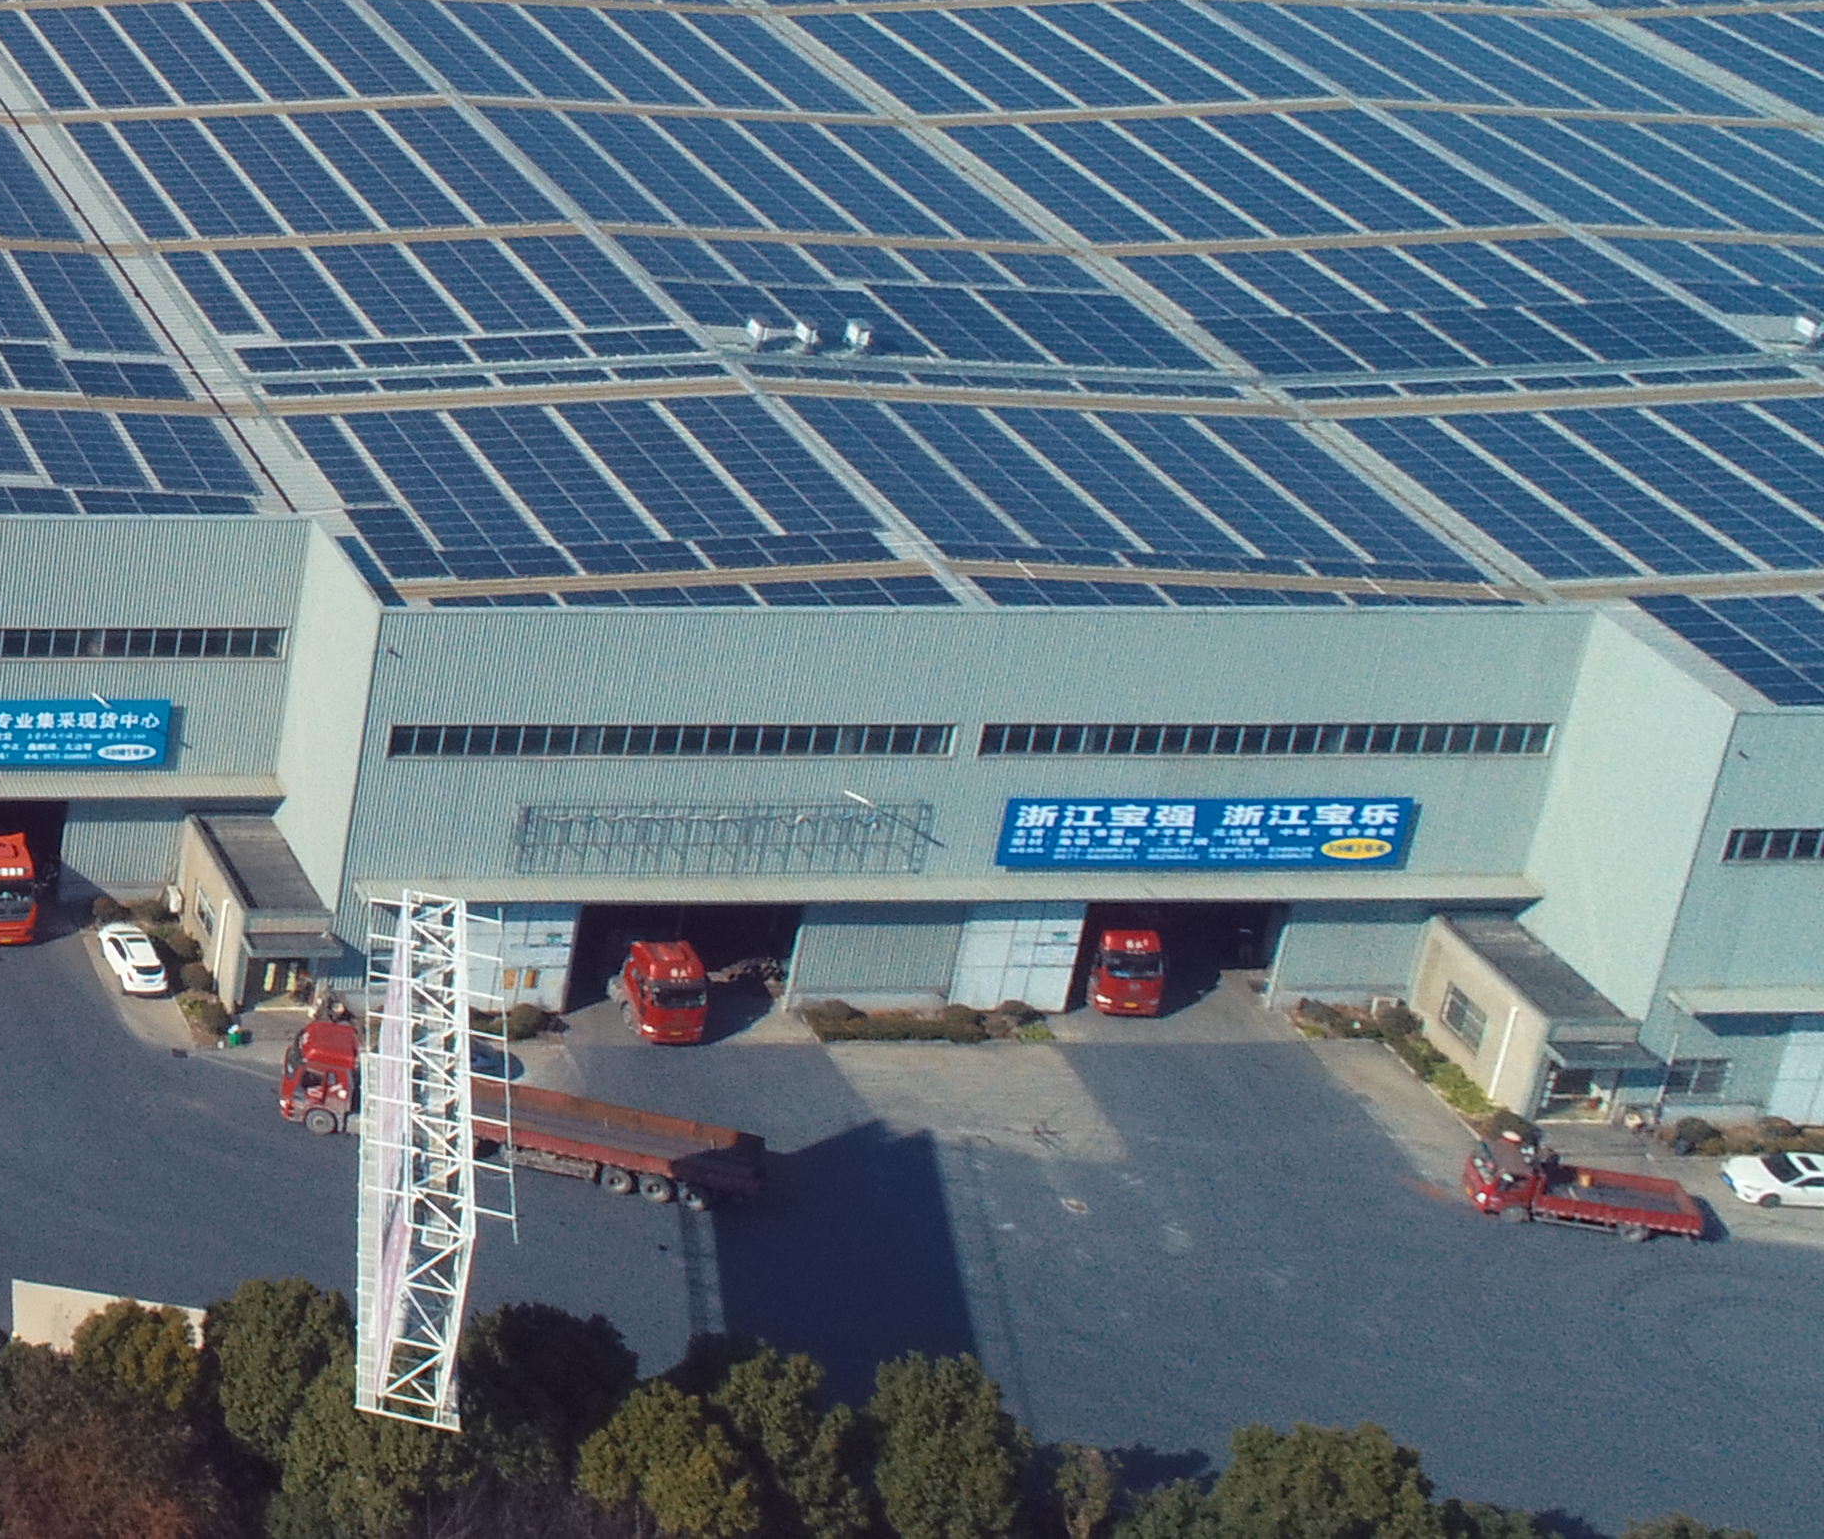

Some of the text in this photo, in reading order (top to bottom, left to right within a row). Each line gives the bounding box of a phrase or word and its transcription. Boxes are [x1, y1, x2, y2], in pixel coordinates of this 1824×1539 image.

[1014, 804, 1400, 827] 浙江宝强 浙江宝乐
